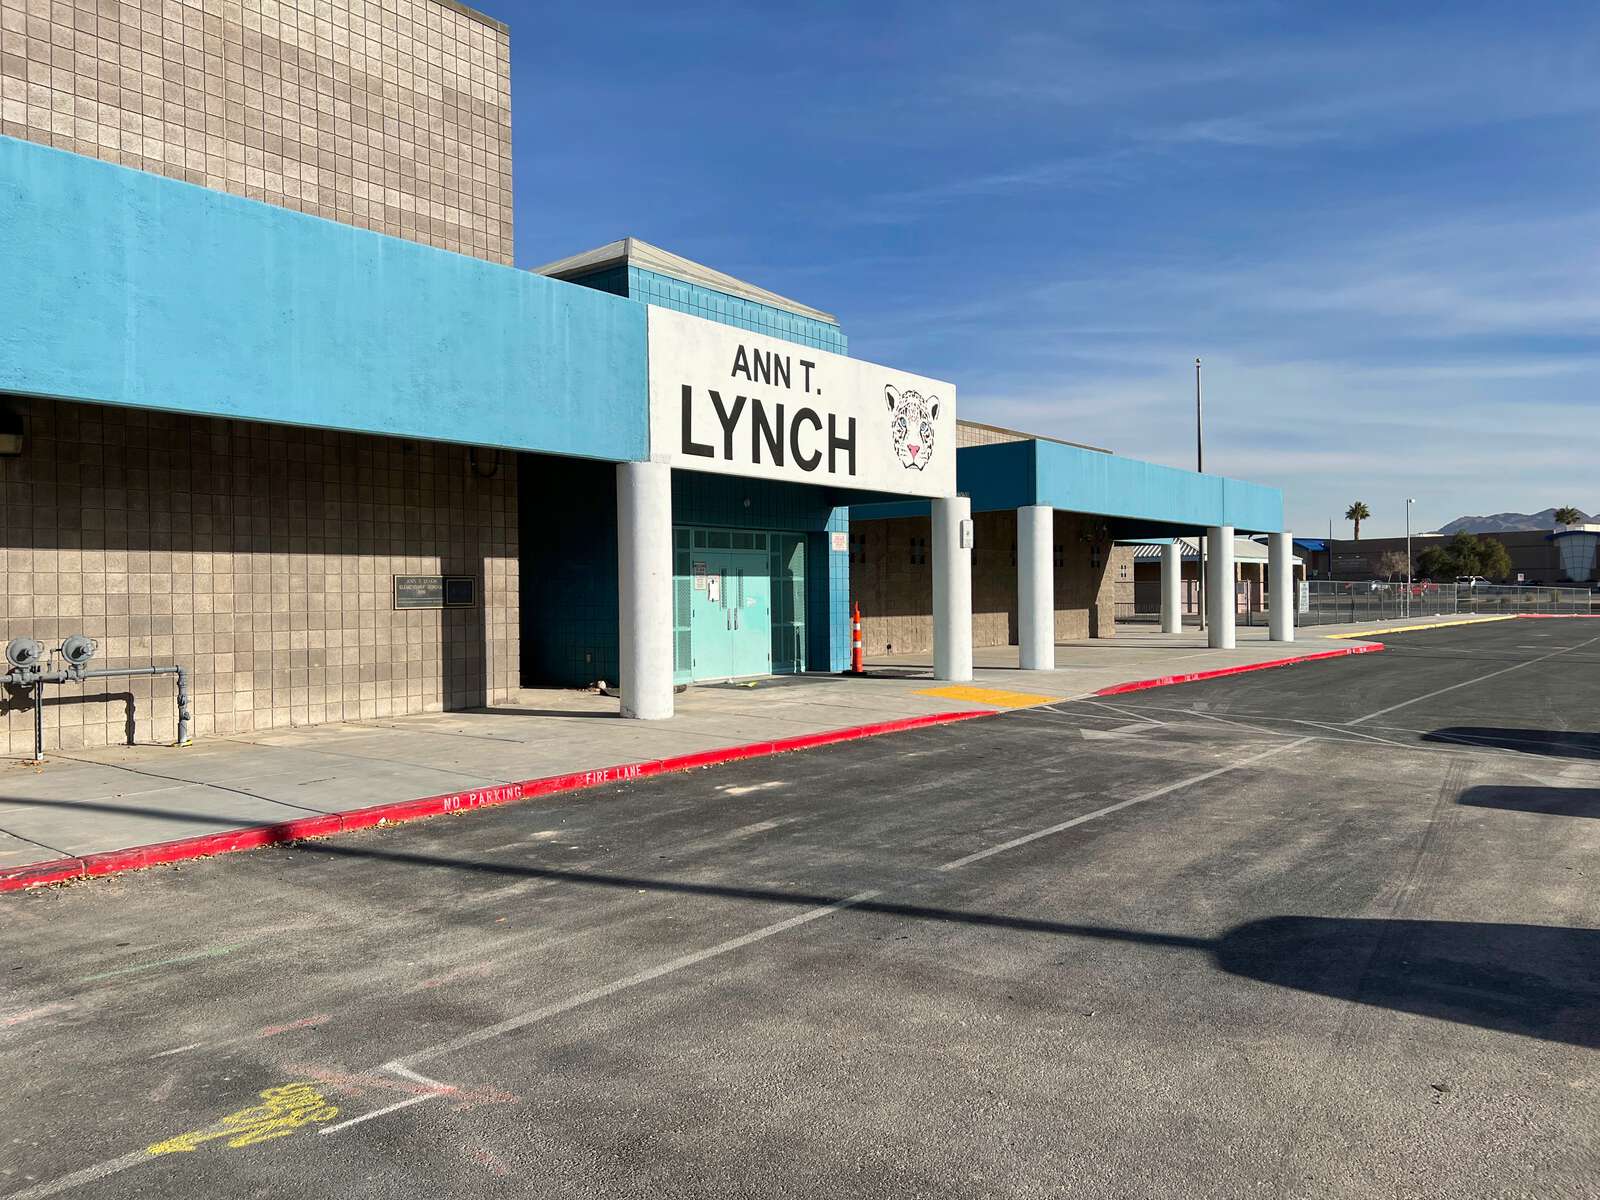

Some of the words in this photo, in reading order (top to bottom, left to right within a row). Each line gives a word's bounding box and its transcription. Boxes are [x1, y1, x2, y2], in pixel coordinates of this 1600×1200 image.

[731, 344, 791, 389] ANN
[799, 359, 822, 395] T.
[681, 384, 856, 476] LYNCH
[586, 770, 608, 784] FIRE
[616, 764, 641, 779] LANE
[443, 796, 460, 810] NO
[469, 786, 521, 806] PARKING
